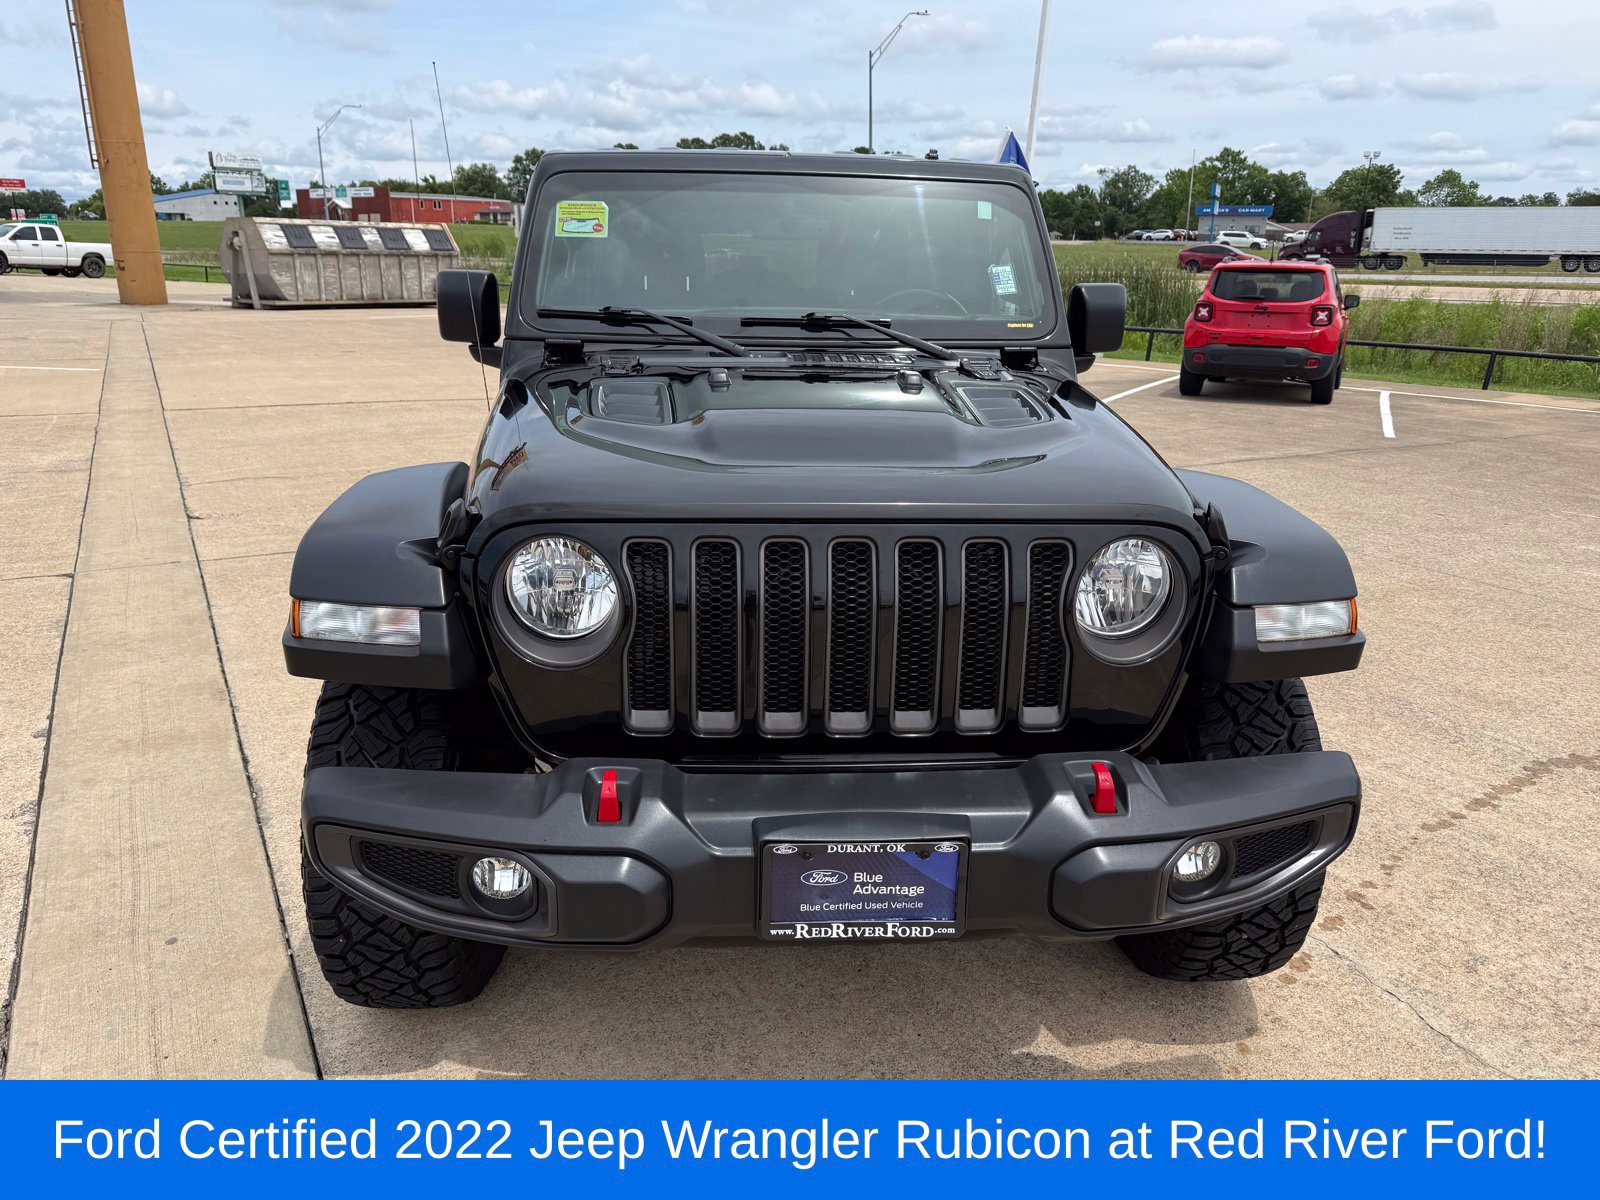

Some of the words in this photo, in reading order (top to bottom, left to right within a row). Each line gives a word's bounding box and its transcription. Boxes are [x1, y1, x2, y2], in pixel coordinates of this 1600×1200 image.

[827, 844, 883, 853] DURANT,
[886, 844, 906, 852] OK
[853, 872, 883, 883] Blue
[852, 884, 925, 897] Advantage
[800, 903, 821, 912] Blue
[823, 902, 863, 911] Certified
[865, 901, 888, 910] Used
[890, 901, 924, 909] Vehicle
